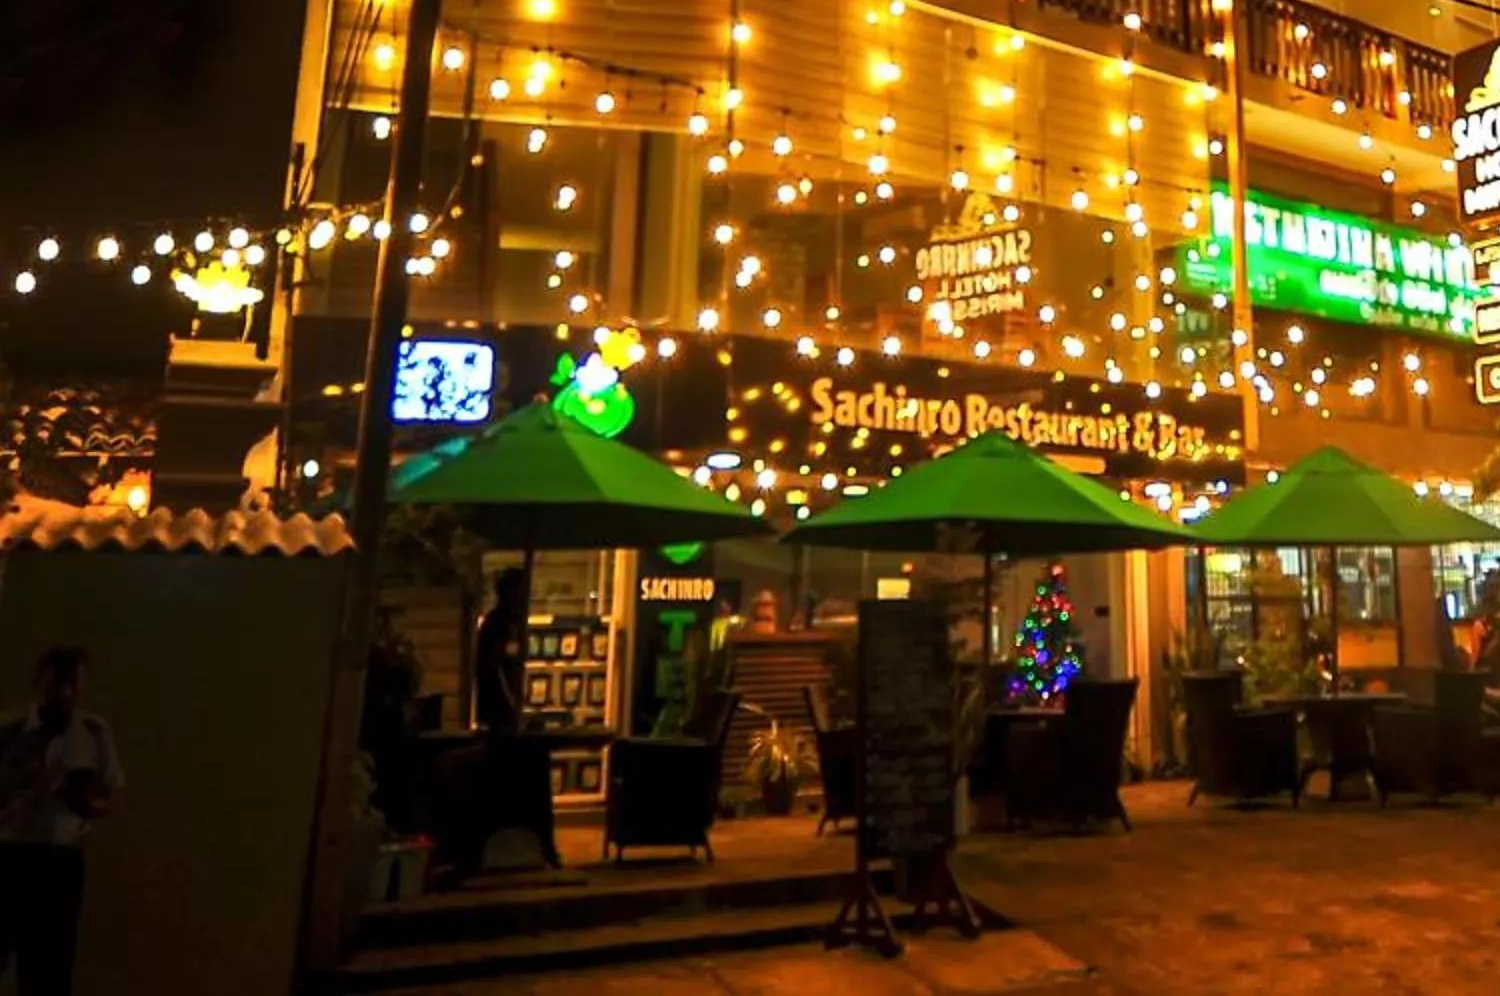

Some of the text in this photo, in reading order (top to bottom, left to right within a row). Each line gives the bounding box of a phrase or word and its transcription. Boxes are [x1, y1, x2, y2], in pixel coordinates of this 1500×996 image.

[1399, 238, 1476, 291] WIN
[966, 393, 1130, 453] Restaurant
[1132, 412, 1157, 451] &
[641, 578, 715, 601] SACHINRO
